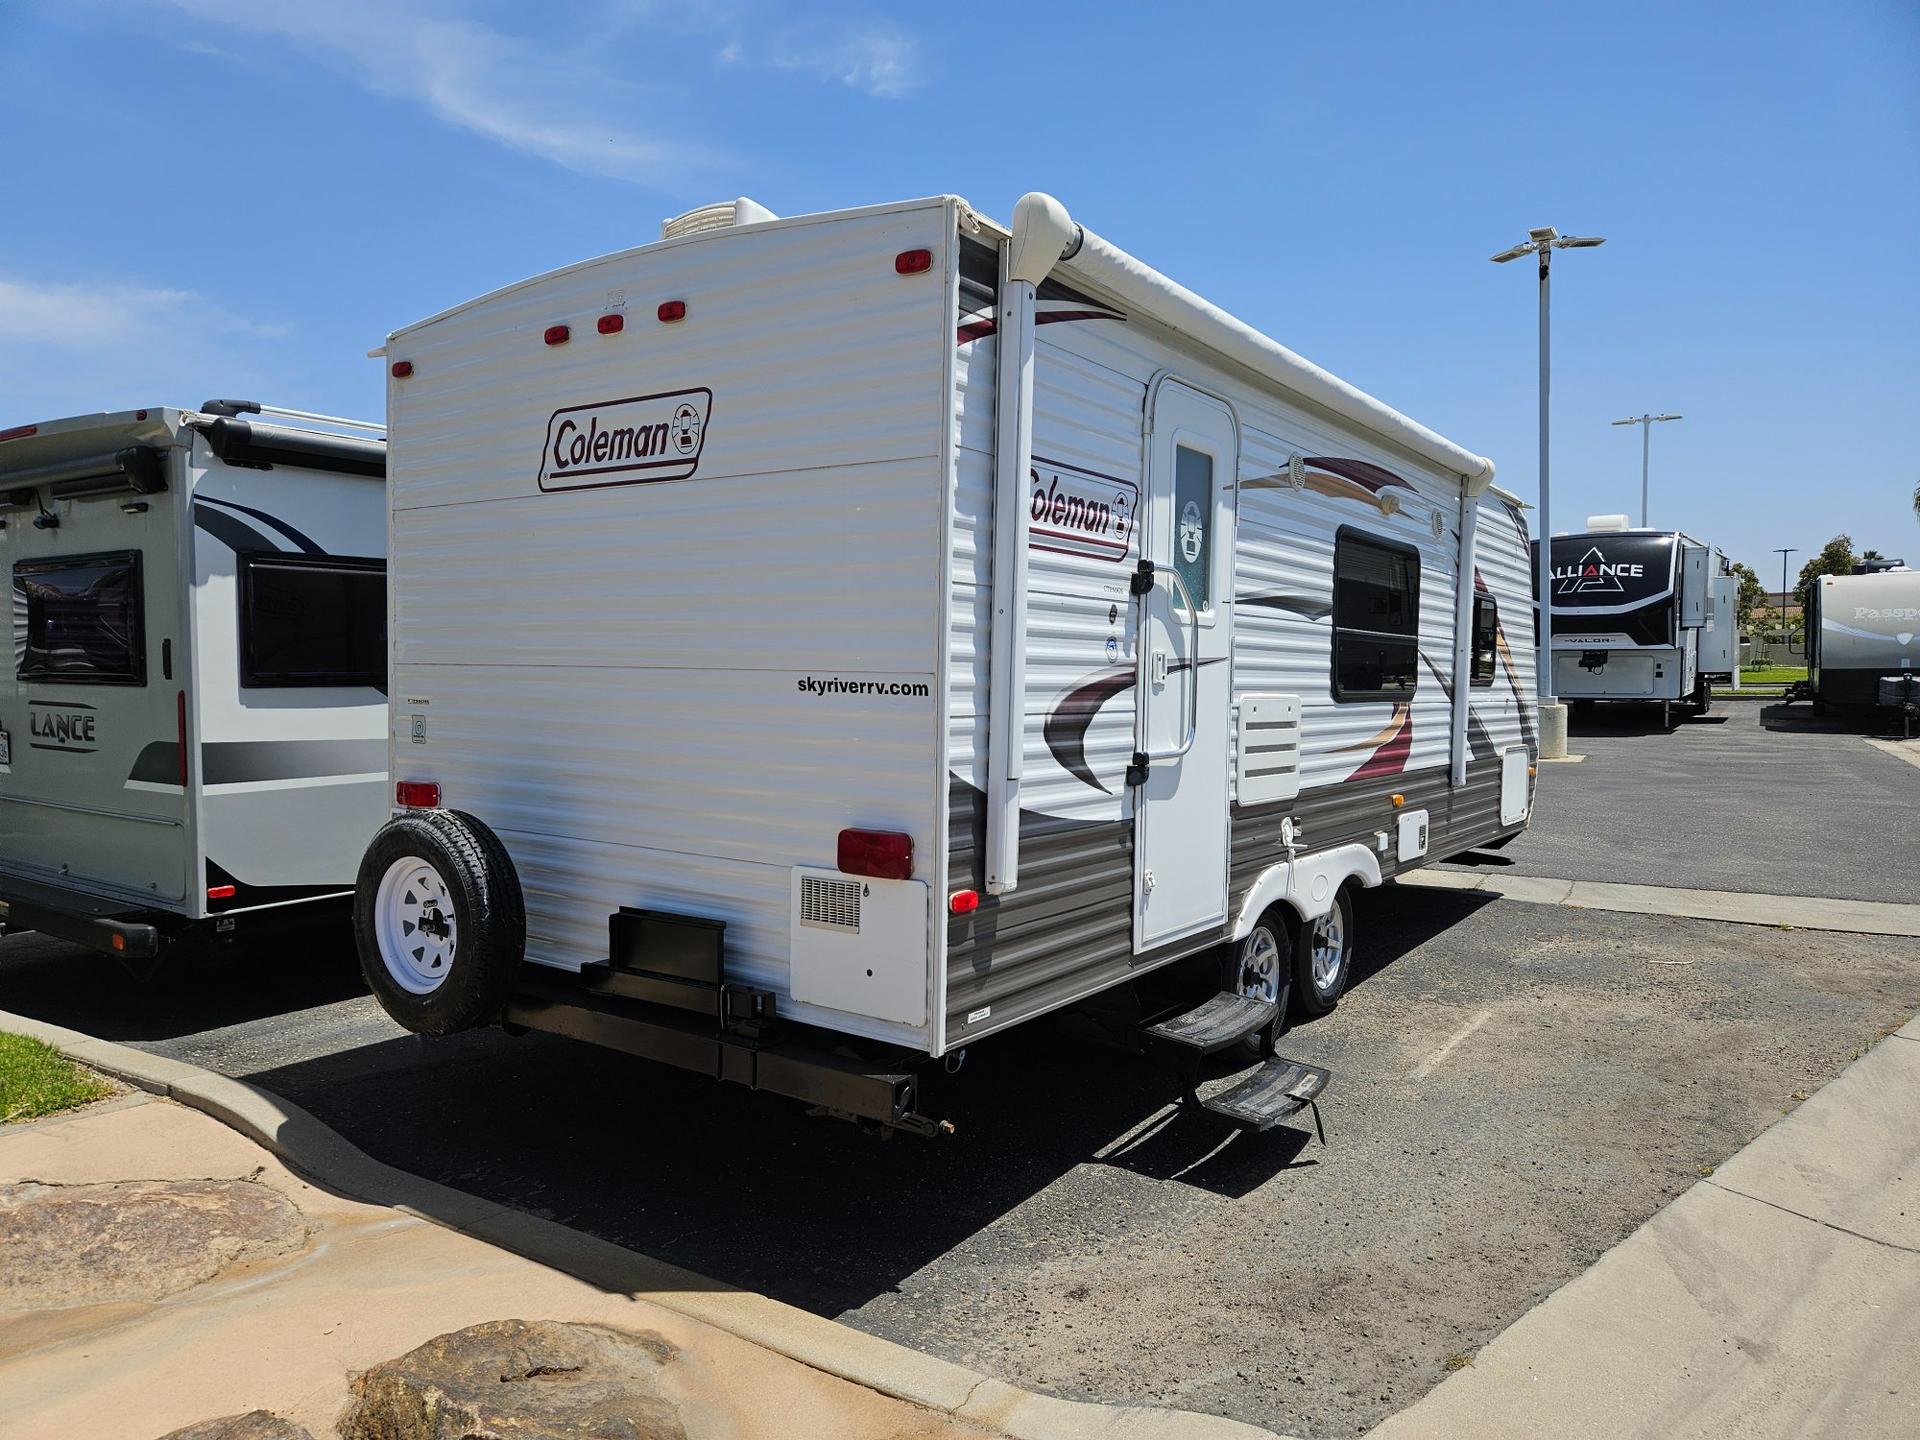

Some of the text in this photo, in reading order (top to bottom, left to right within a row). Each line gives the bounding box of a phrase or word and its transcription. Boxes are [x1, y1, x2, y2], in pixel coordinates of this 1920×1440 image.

[554, 416, 669, 469] Coleman
[1853, 607, 1920, 621] Passp
[798, 676, 929, 697] skyriverrv.com
[30, 711, 96, 743] LANCE
